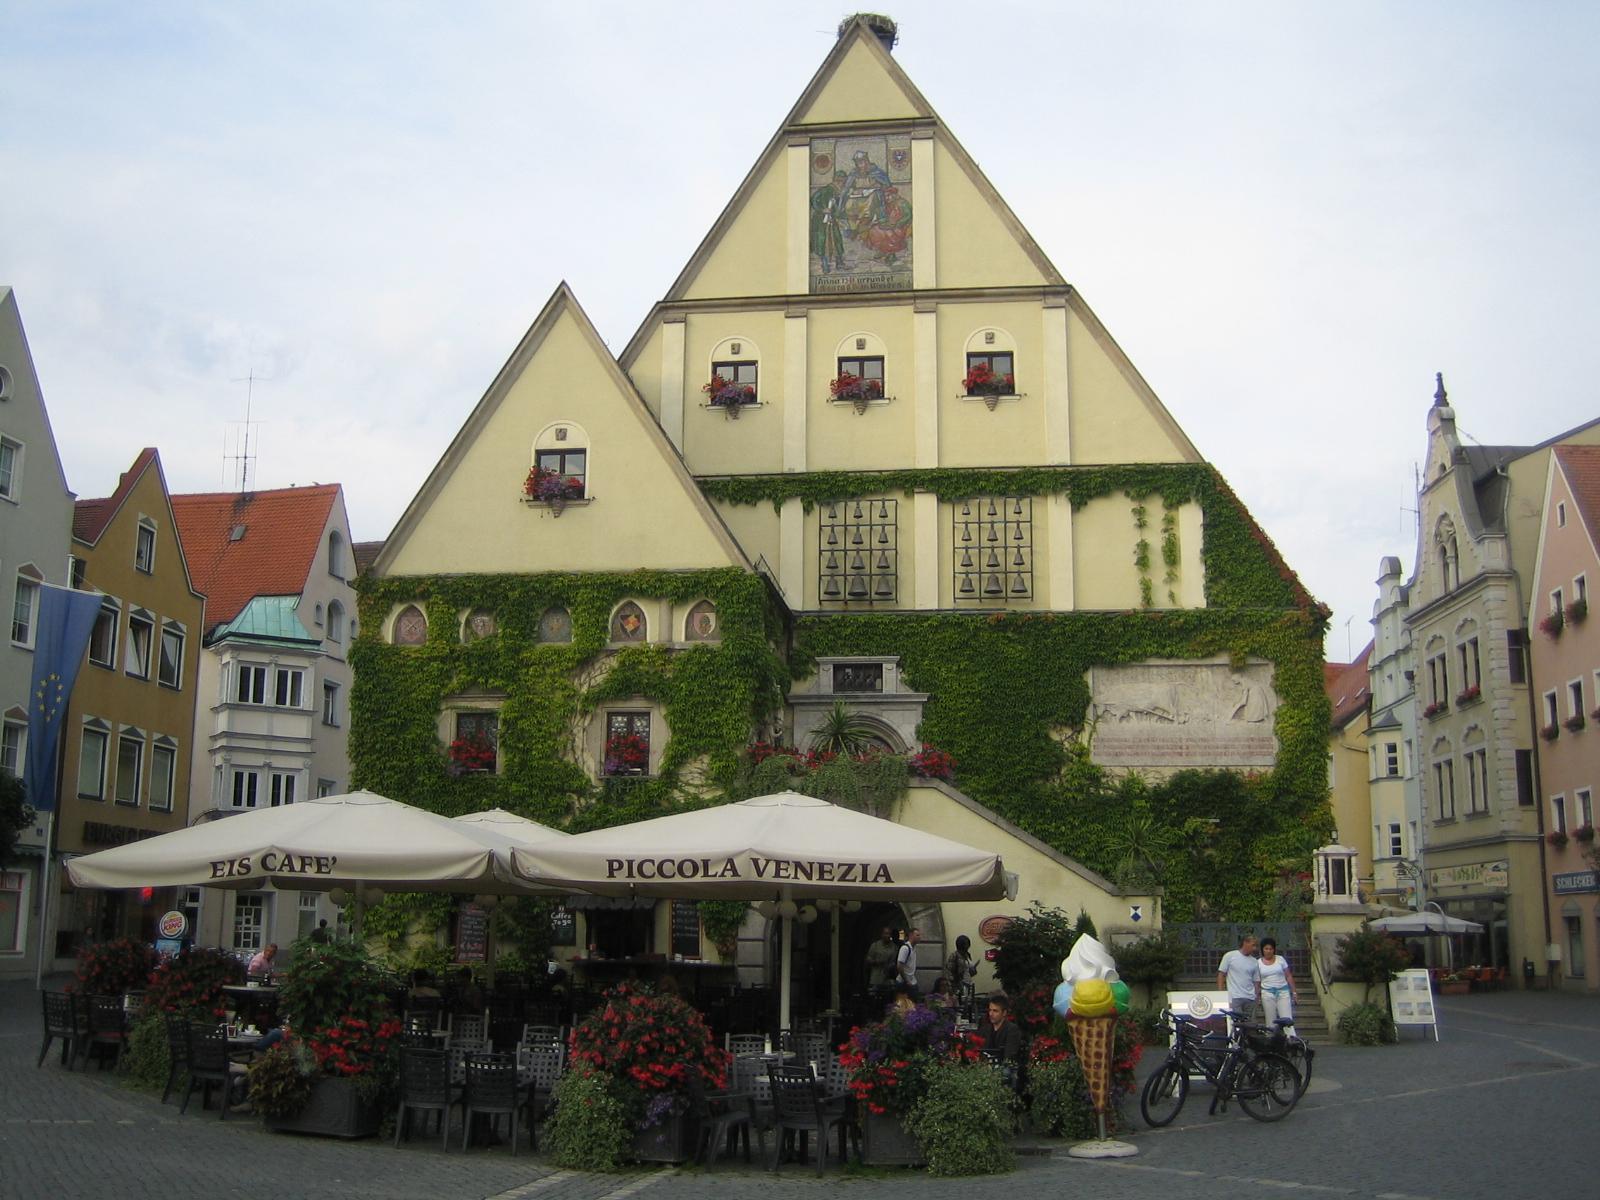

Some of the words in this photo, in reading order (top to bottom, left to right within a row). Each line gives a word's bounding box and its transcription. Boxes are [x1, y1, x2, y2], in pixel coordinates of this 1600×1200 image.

[209, 857, 252, 879] EIS
[606, 857, 742, 879] PICCOLA
[750, 857, 895, 883] VENEZIA
